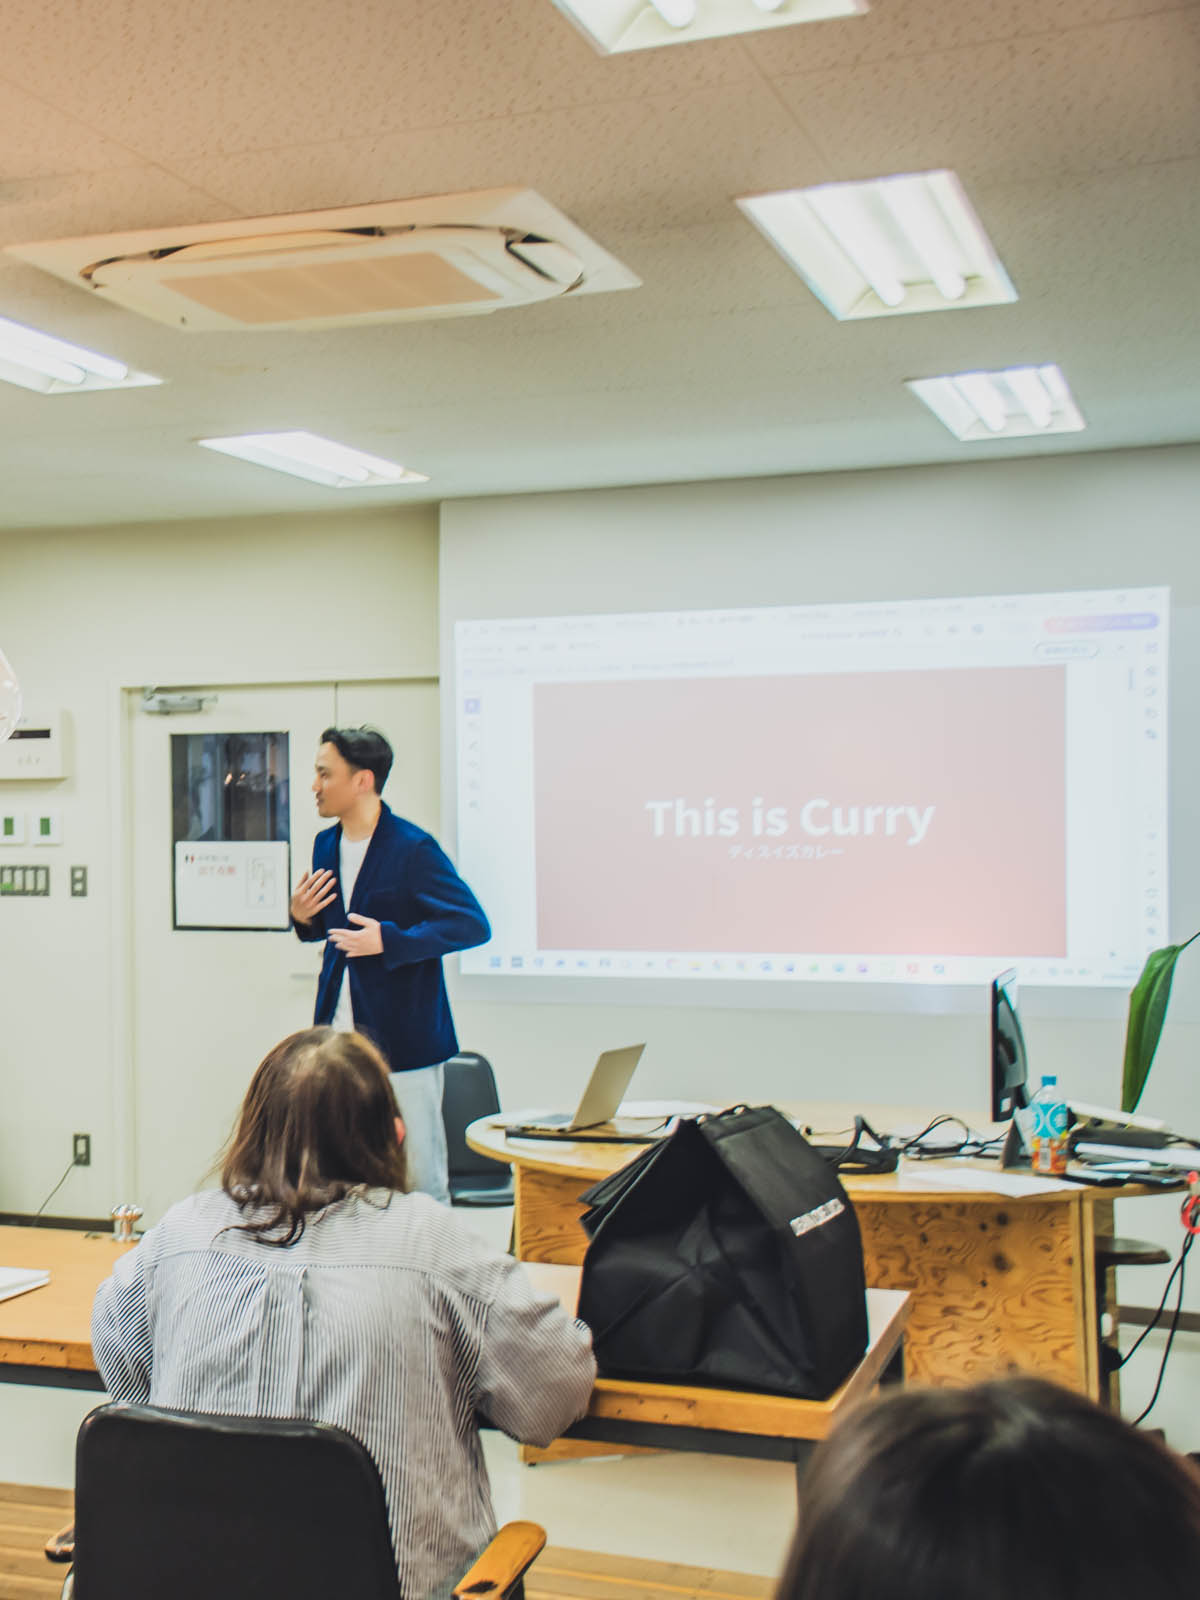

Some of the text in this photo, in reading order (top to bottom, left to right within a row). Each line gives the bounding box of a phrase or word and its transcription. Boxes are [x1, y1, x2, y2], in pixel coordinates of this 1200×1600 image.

[645, 795, 937, 846] This is Curry
[728, 844, 845, 860] ディスイズカレー
